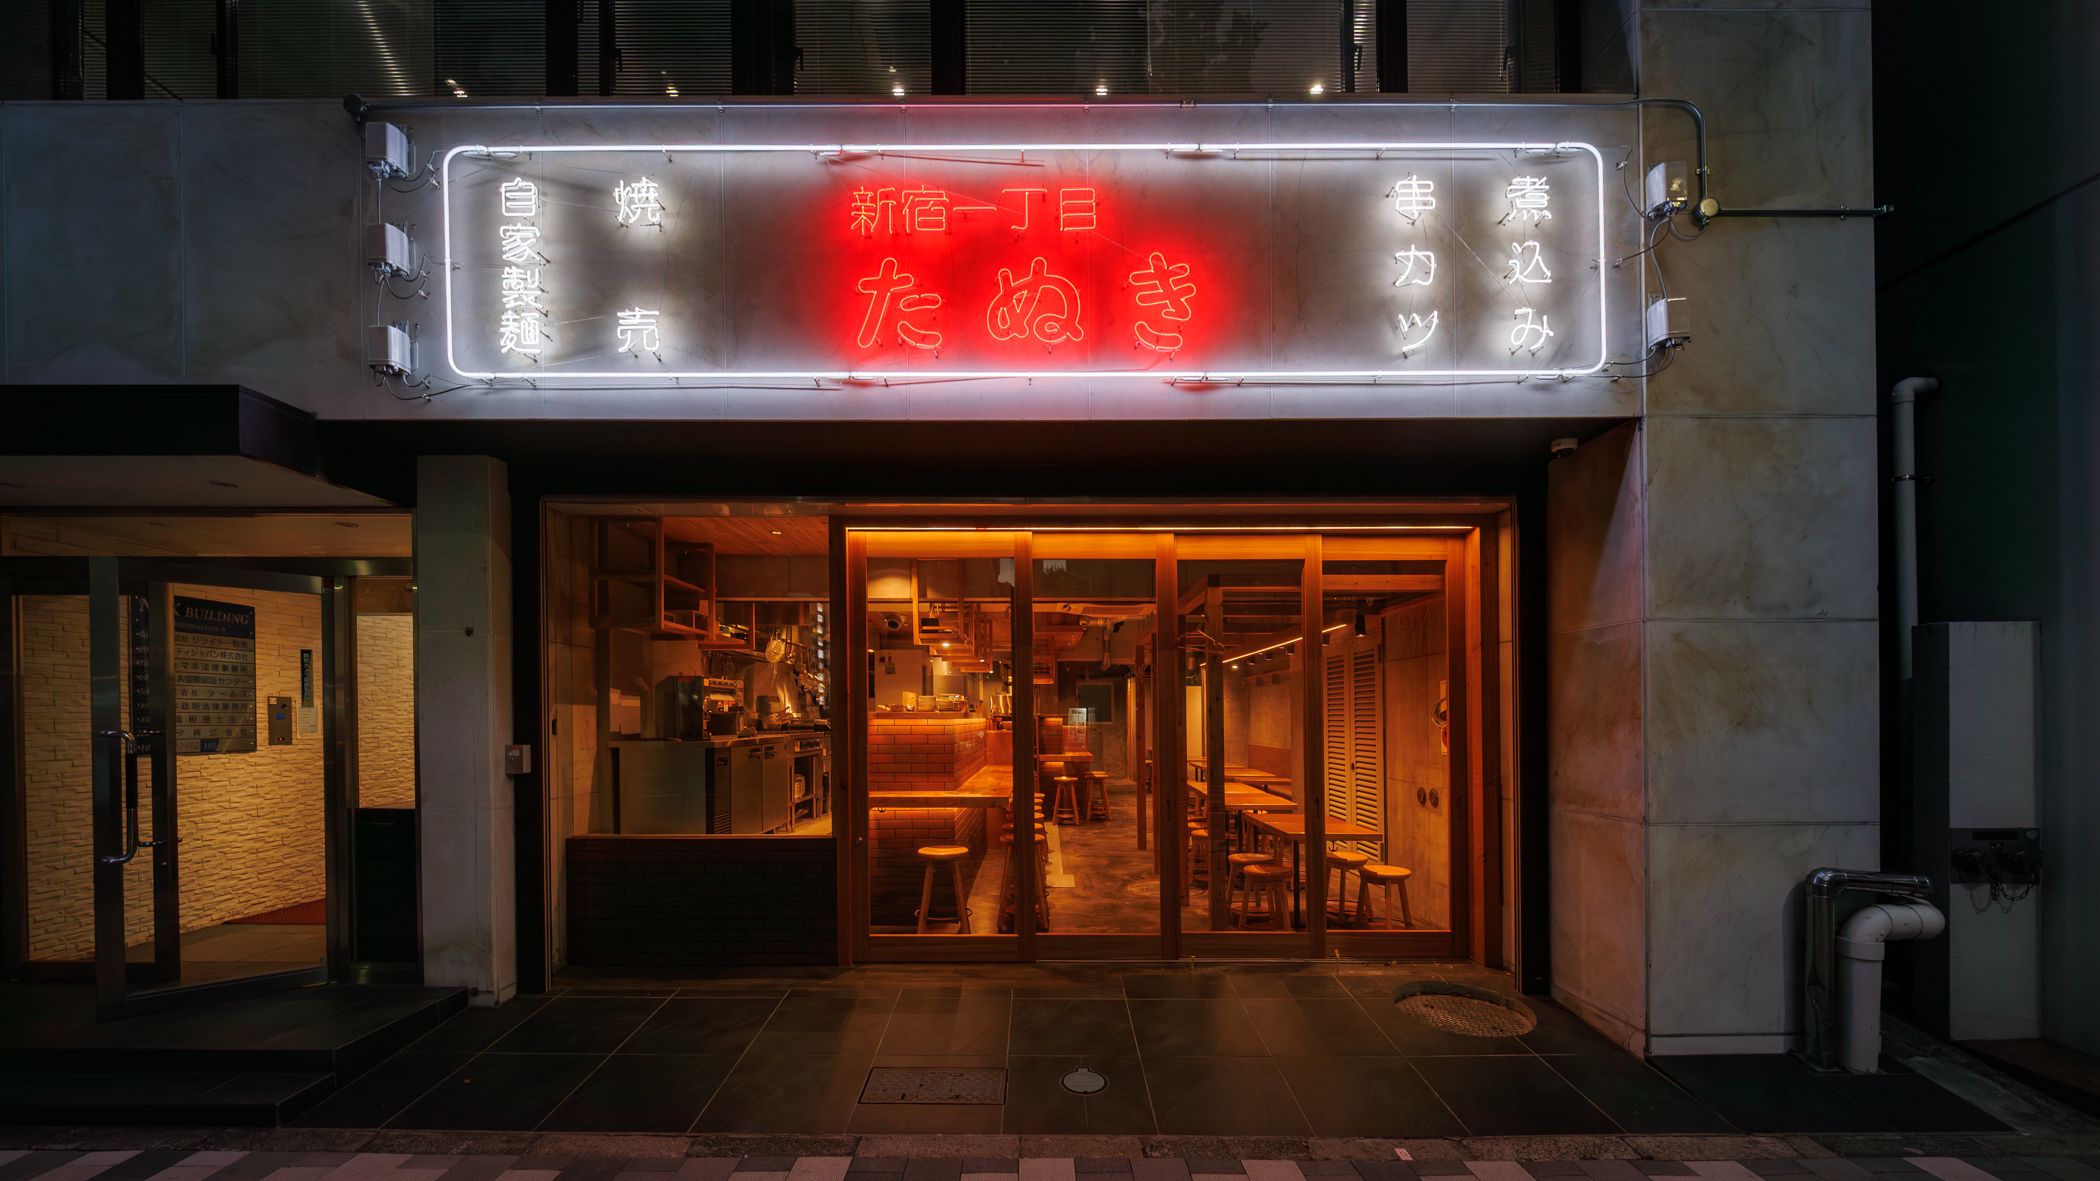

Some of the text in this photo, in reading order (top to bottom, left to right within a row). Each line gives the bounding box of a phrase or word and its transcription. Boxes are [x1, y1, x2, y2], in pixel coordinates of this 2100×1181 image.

[614, 176, 661, 353] 焼売
[851, 185, 1096, 235] 新宿一丁目
[1394, 175, 1437, 352] 串カツ
[1506, 176, 1554, 350] 煮込み
[857, 252, 1196, 352] たぬき
[185, 607, 249, 625] BUILDING
